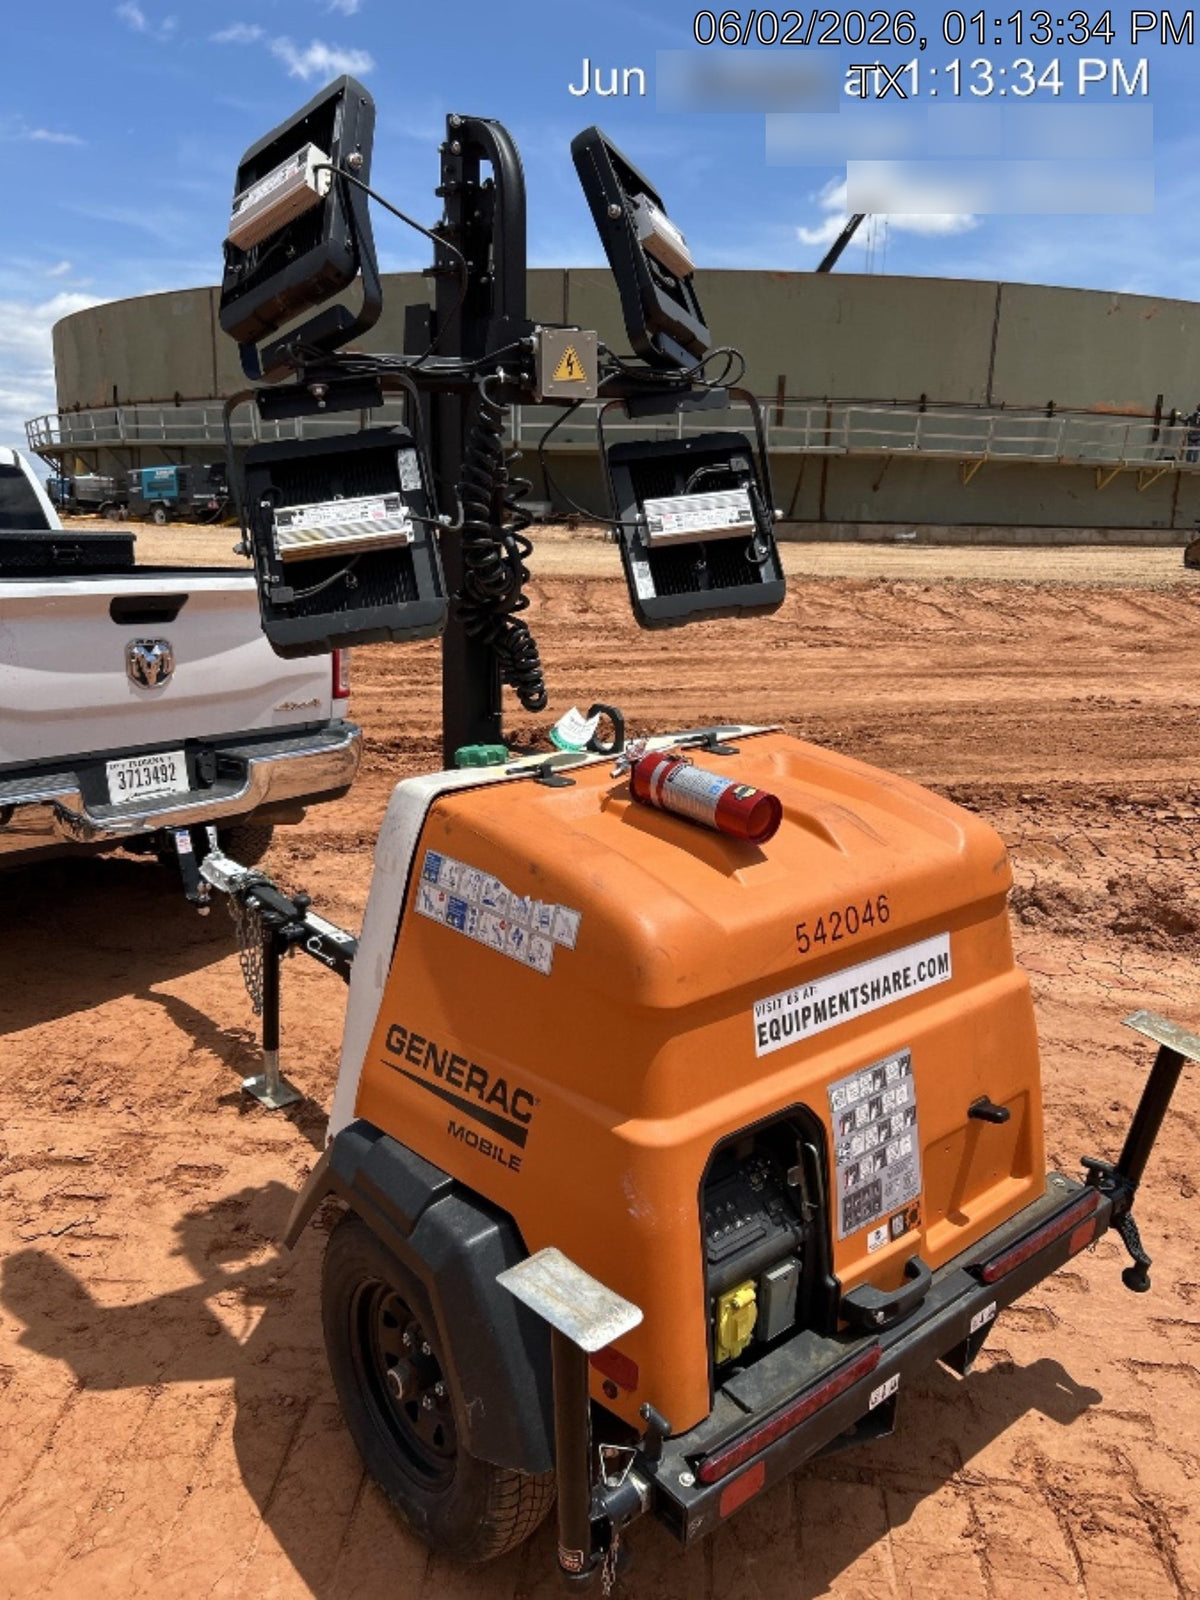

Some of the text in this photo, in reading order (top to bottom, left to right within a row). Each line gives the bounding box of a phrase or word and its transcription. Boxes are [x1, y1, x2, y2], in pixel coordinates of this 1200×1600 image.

[117, 762, 176, 790] 3713492
[796, 895, 890, 953] 542046
[755, 998, 782, 1017] VISIT
[757, 952, 949, 1048] EQUIPMENTSHARE.COM
[385, 1023, 535, 1124] GENERAC
[447, 1120, 522, 1173] MOBILE
